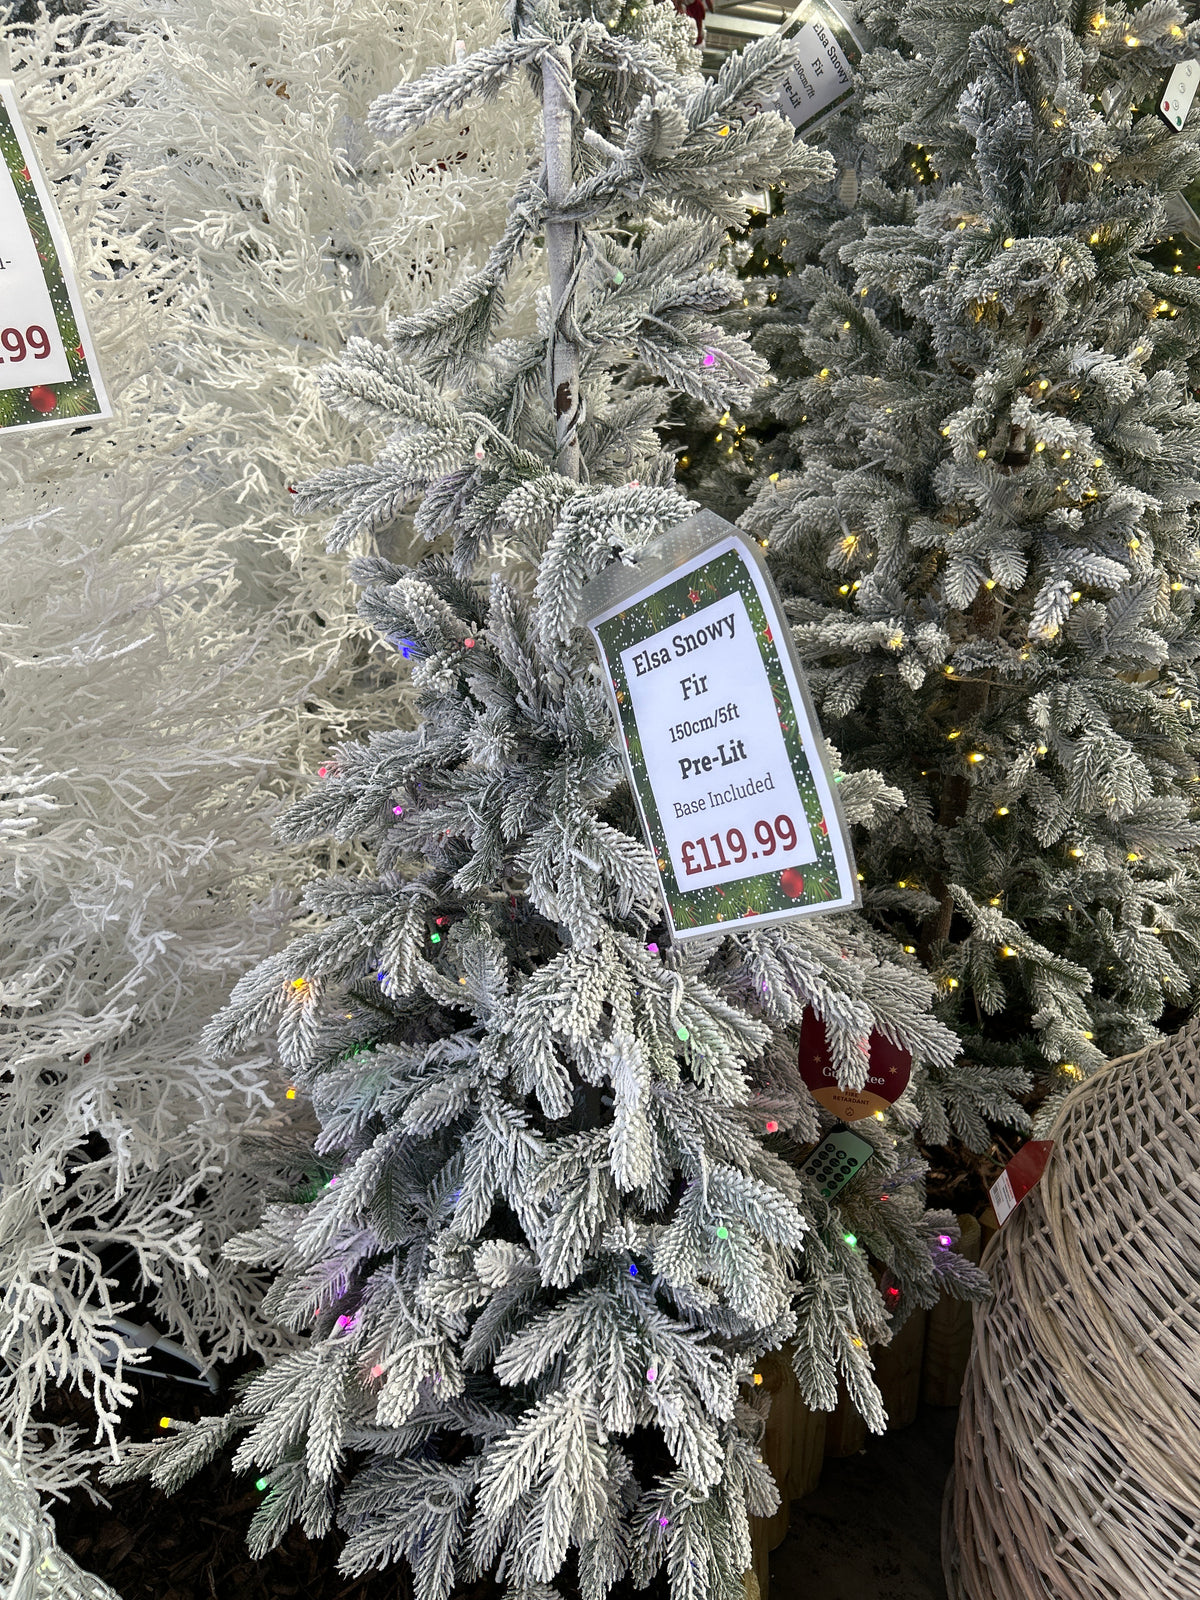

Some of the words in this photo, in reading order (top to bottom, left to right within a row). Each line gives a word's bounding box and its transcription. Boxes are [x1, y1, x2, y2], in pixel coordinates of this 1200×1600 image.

[811, 57, 824, 77] Fir
[812, 22, 830, 49] Elsa
[827, 46, 849, 85] Snowy
[782, 77, 802, 109] re-Lit
[793, 60, 816, 99] 210cm/7ft
[632, 647, 672, 677] Elsa
[671, 612, 736, 657] Snowy
[679, 673, 709, 701] Fir
[668, 702, 740, 743] 150cm/5ft
[677, 738, 748, 780] Pre-Lit
[672, 797, 707, 819] Base
[708, 772, 775, 808] Included
[681, 814, 798, 876] £119.99
[832, 1095, 870, 1105] RETARDANT
